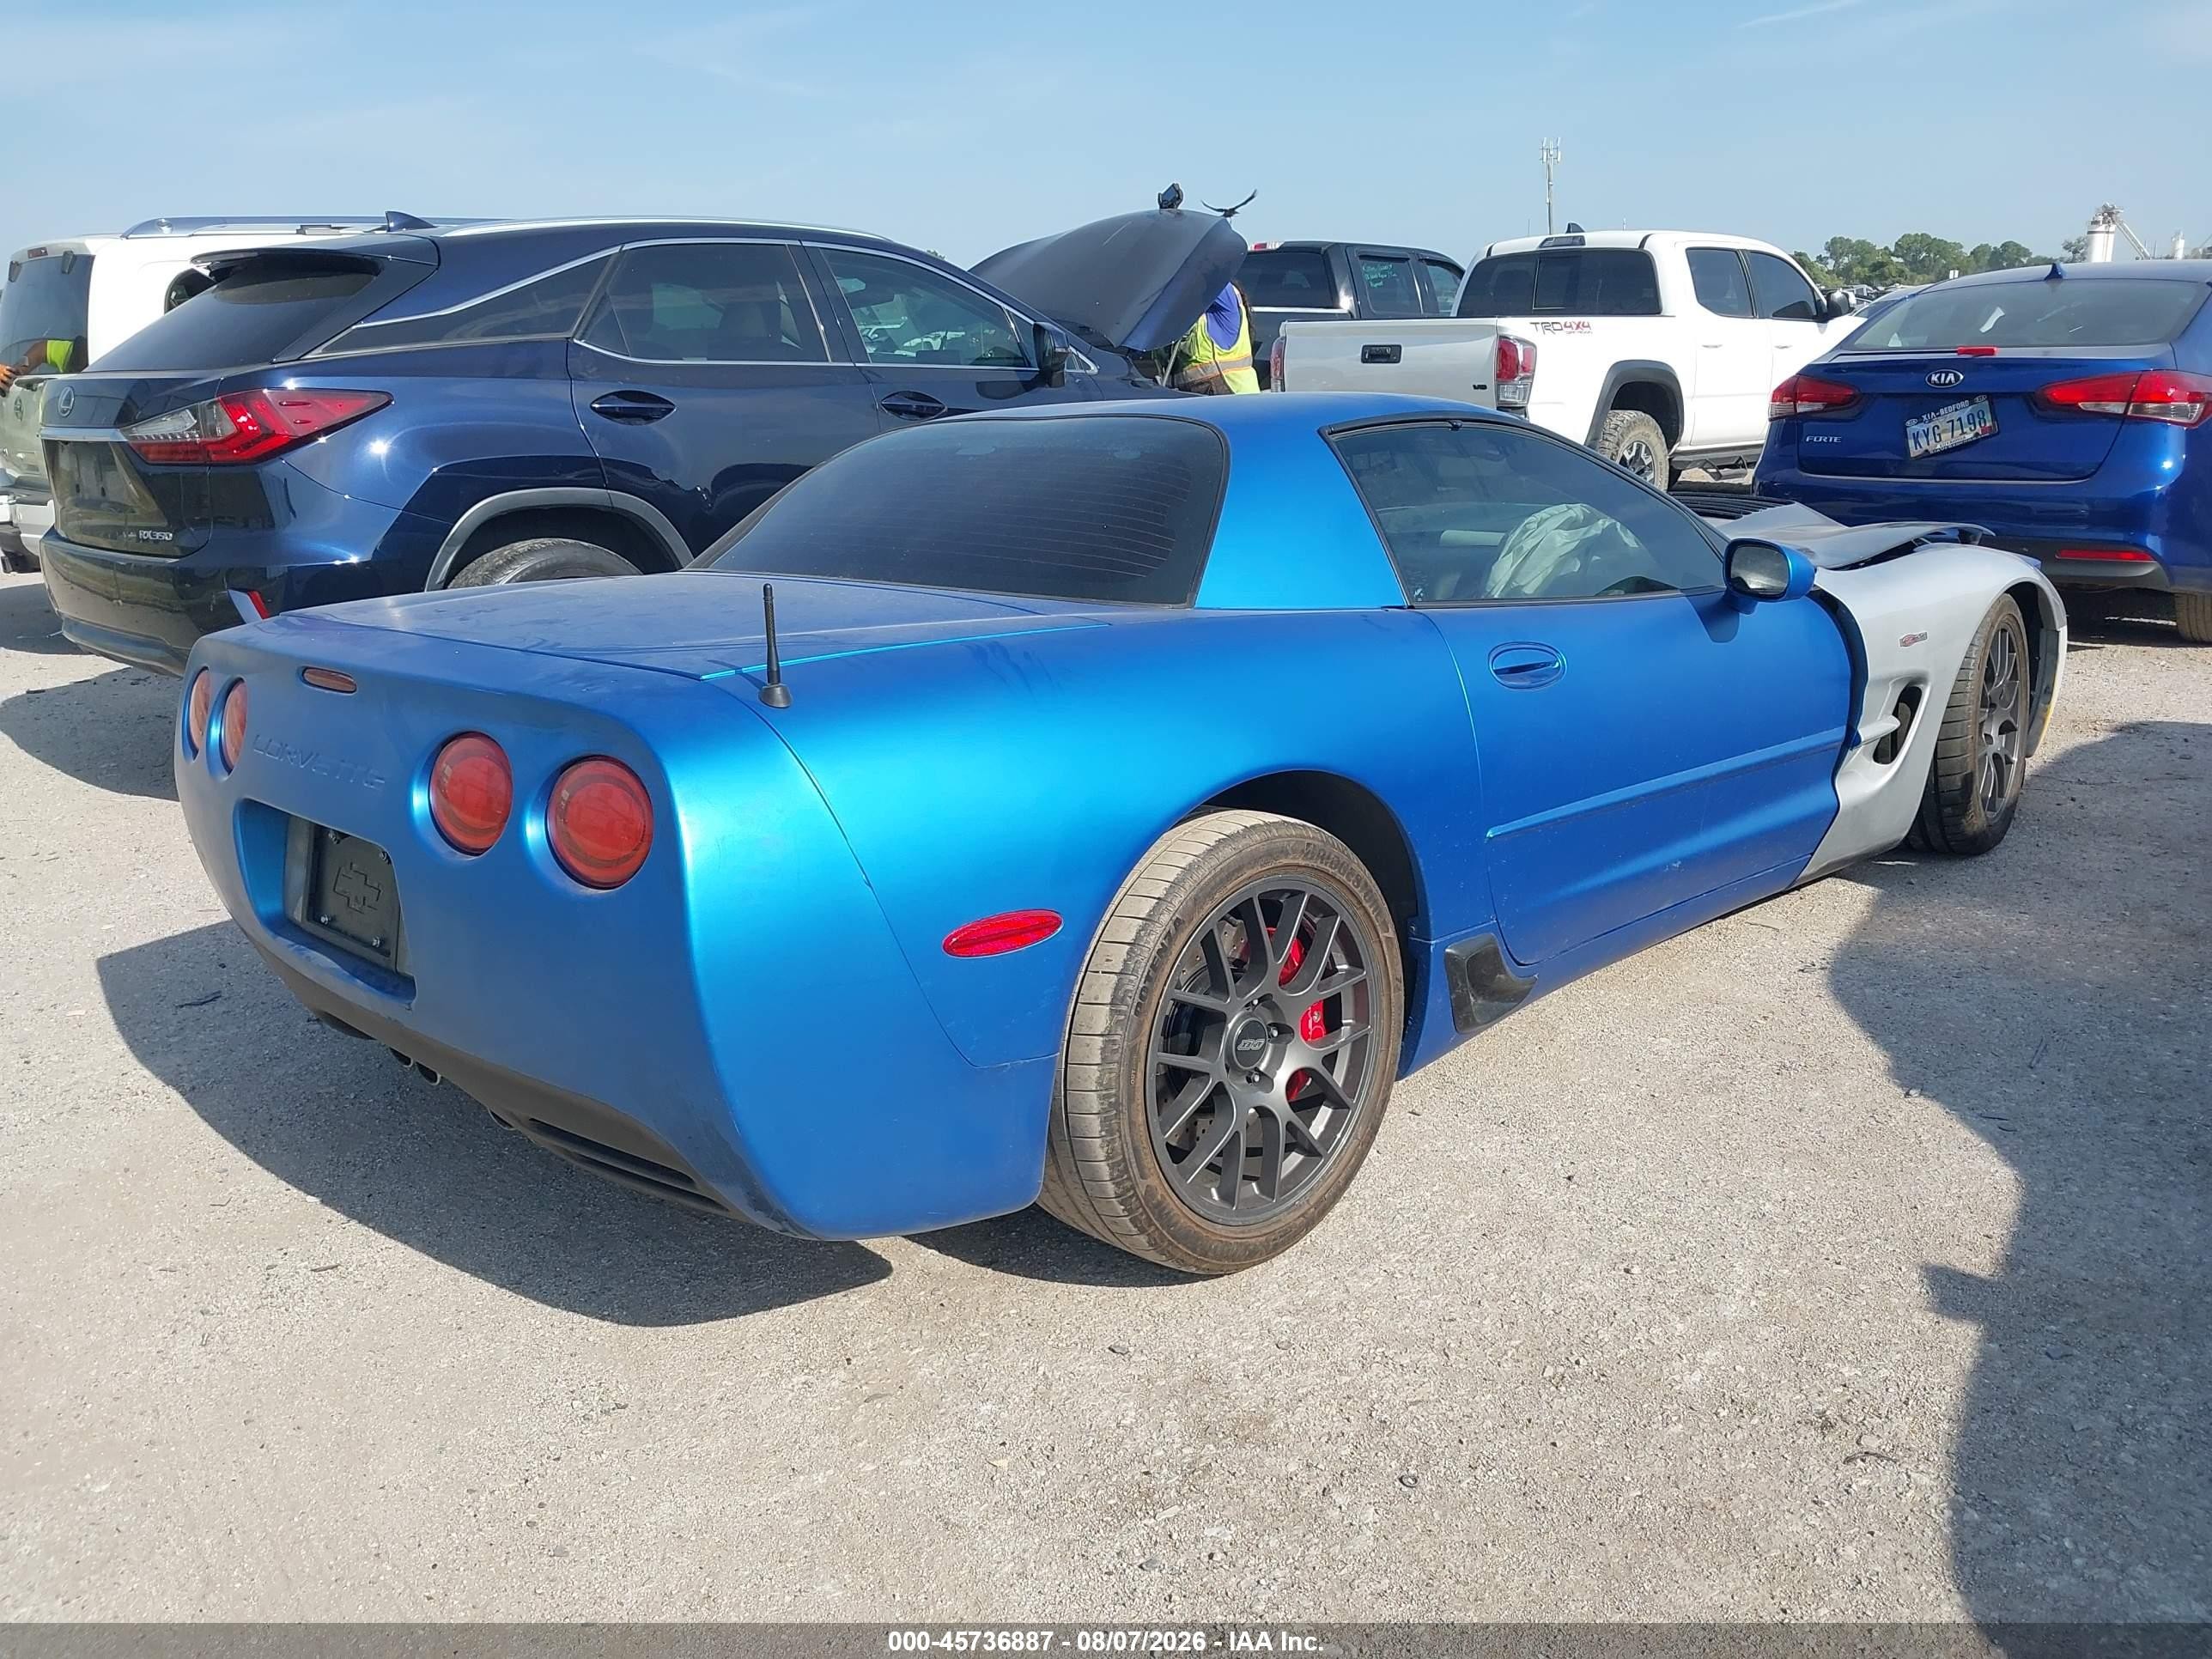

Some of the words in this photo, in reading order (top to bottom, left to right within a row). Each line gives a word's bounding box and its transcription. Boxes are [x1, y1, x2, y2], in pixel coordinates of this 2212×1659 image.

[1529, 321, 1564, 335] TRD
[1930, 373, 1956, 384] KIA
[1912, 424, 1942, 451] KYG
[1946, 409, 1988, 439] 7198
